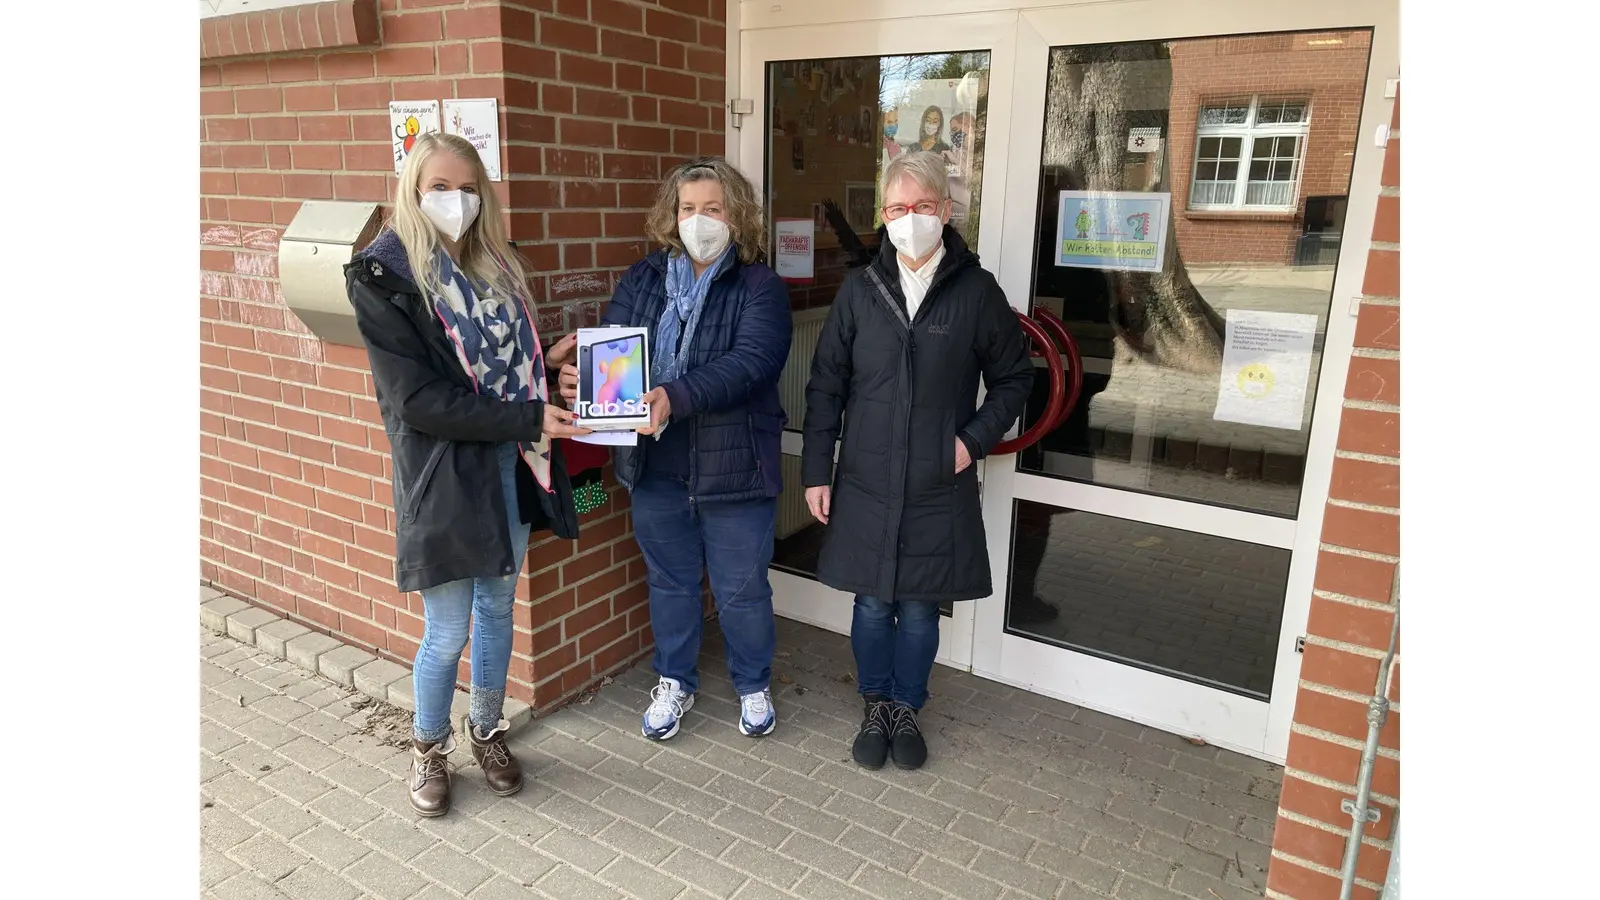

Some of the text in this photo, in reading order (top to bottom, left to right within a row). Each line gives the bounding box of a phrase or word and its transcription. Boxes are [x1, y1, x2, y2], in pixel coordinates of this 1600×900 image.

[463, 126, 475, 135] Wir
[1066, 242, 1155, 256] Wir halten Abstand!
[579, 399, 649, 417] Tab S6
